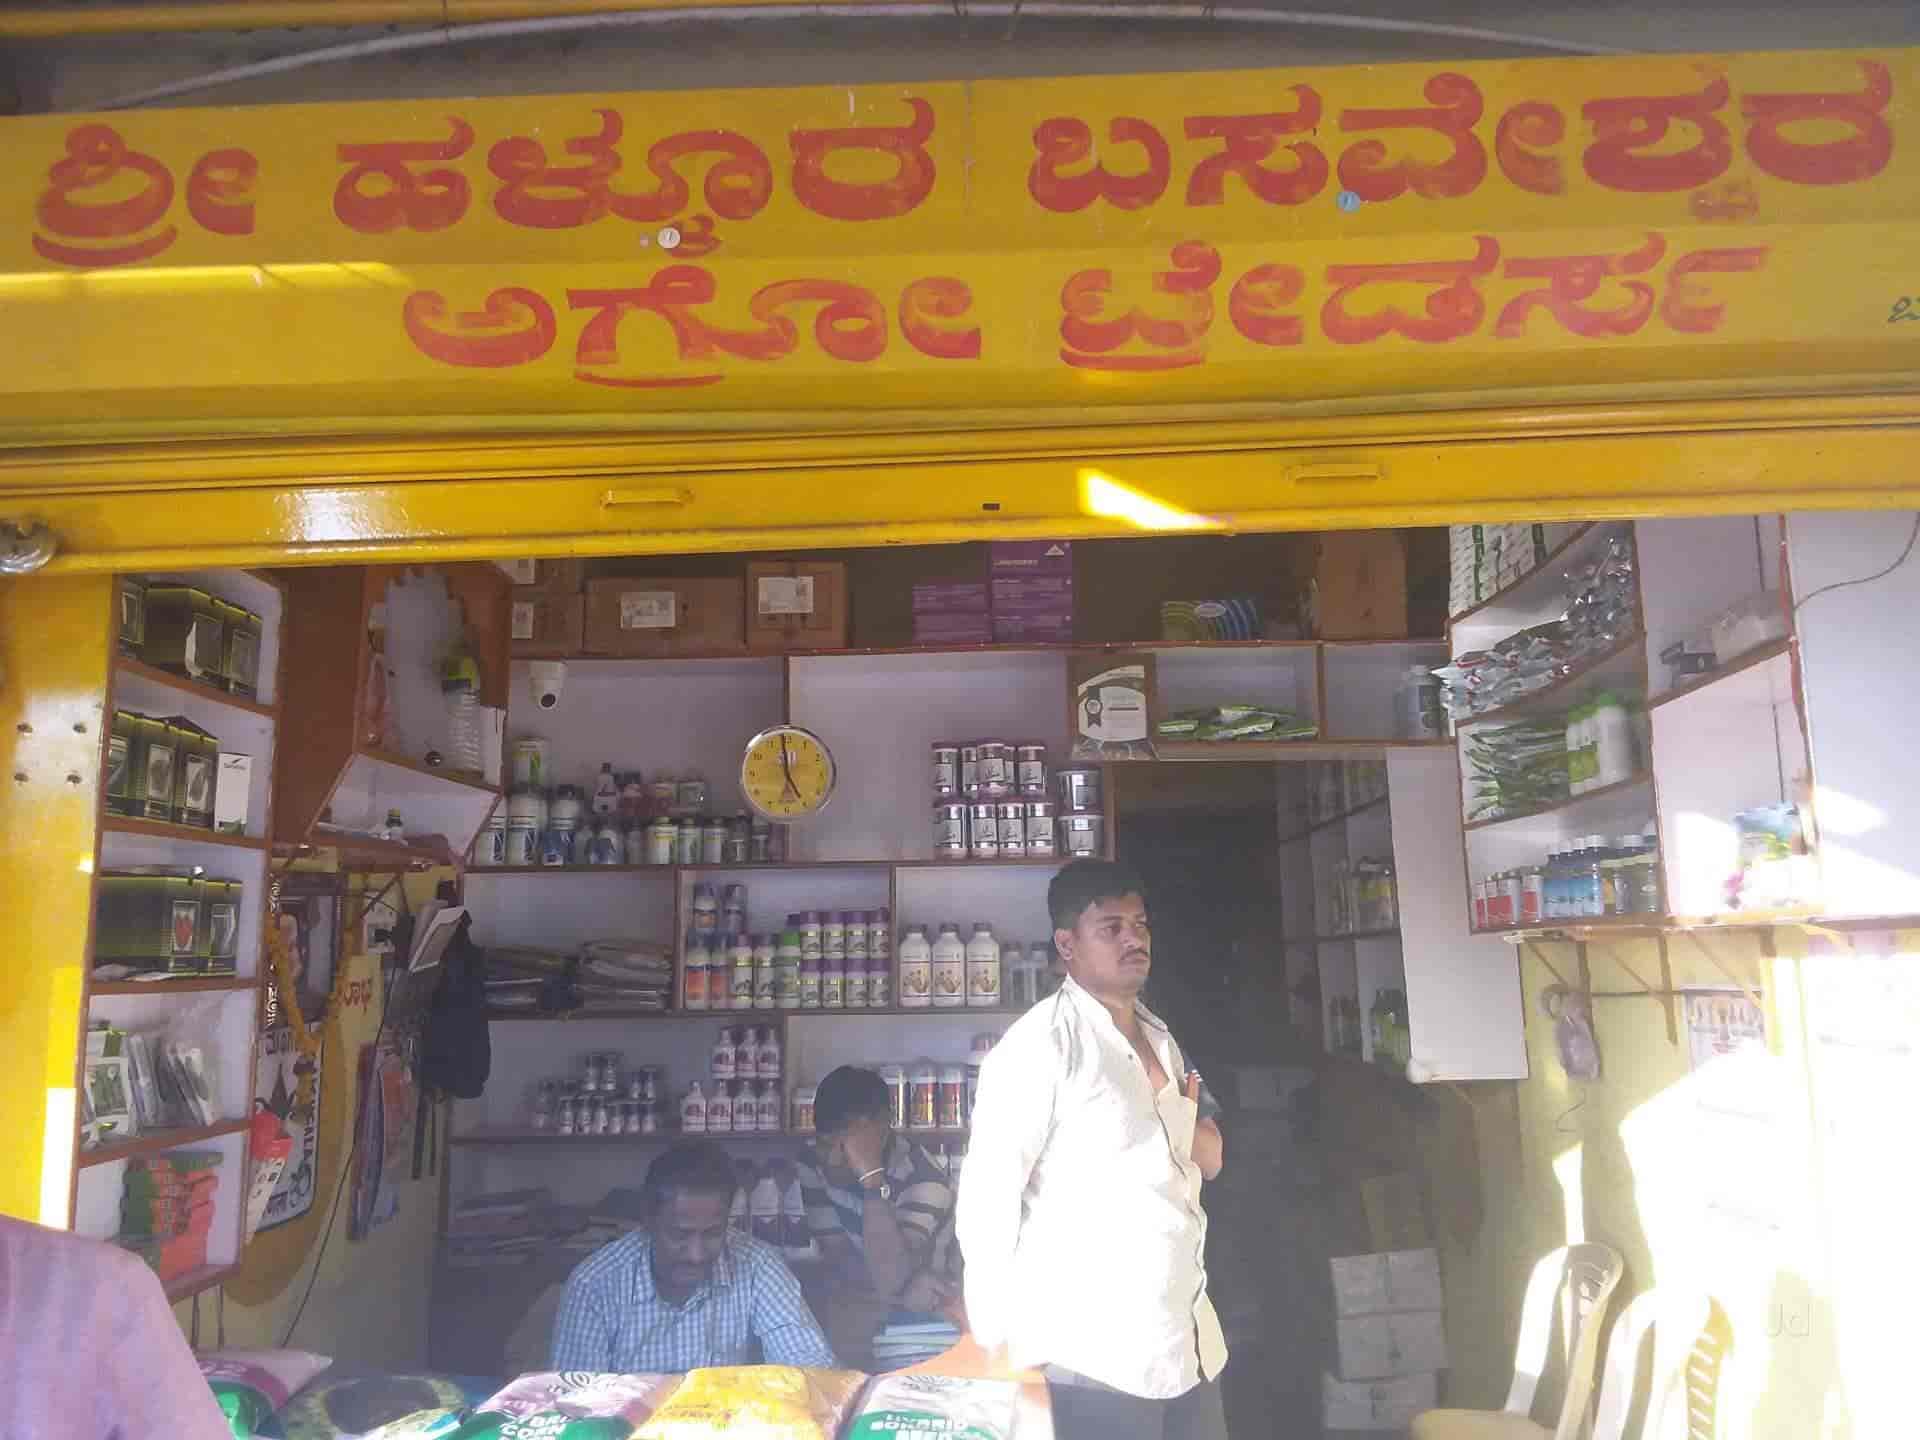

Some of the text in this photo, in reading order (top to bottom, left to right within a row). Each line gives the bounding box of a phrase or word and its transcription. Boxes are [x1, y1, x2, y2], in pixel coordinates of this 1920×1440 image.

[31, 123, 258, 268] ಶ್ರೀ
[1027, 58, 1893, 221] ಬಸವೇಶ್ವರ
[402, 264, 982, 388] ಅಗ್ರೋ
